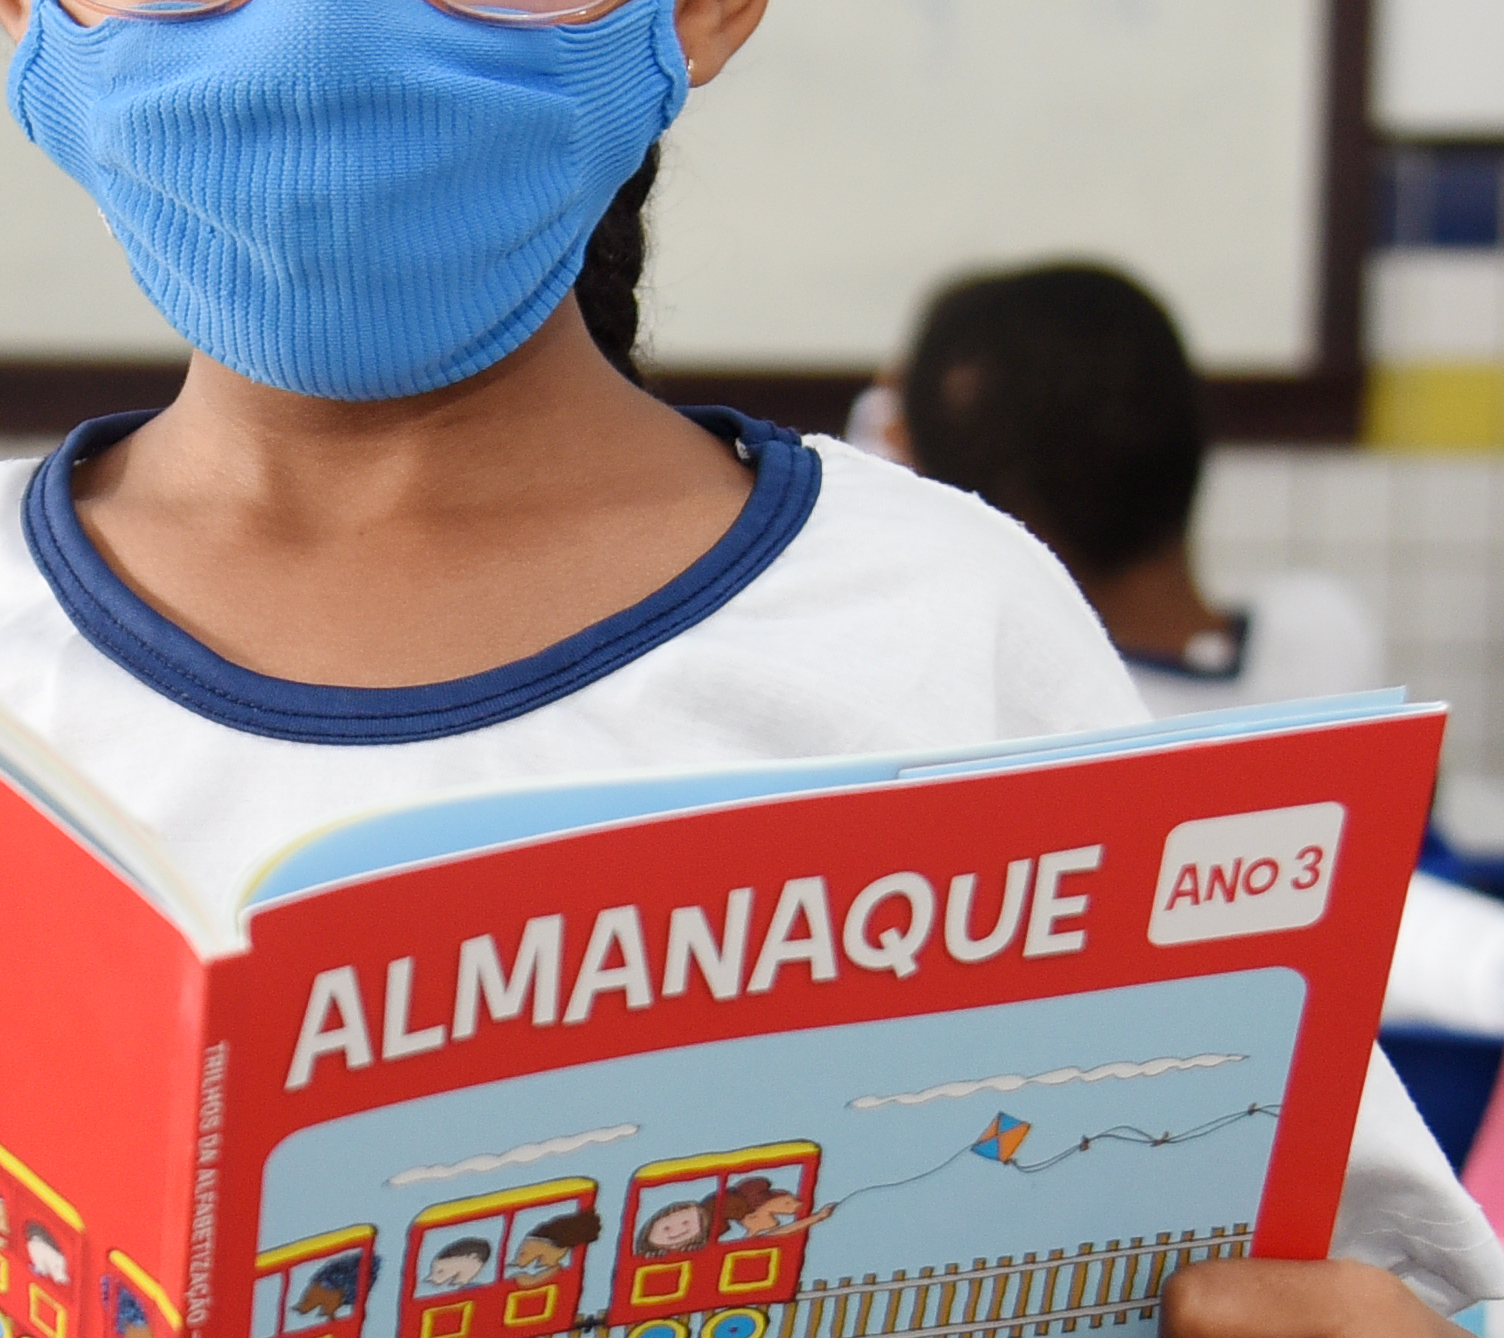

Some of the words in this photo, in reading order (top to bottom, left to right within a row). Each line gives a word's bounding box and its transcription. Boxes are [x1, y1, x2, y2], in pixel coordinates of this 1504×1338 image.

[1164, 856, 1279, 911] ANO
[1291, 845, 1324, 891] 3
[284, 843, 1104, 1091] ALMANAQUE
[199, 1040, 229, 1132] TRILHOS
[197, 1133, 221, 1167] DA
[185, 1169, 216, 1326] ALFABETIZAÇÃO
